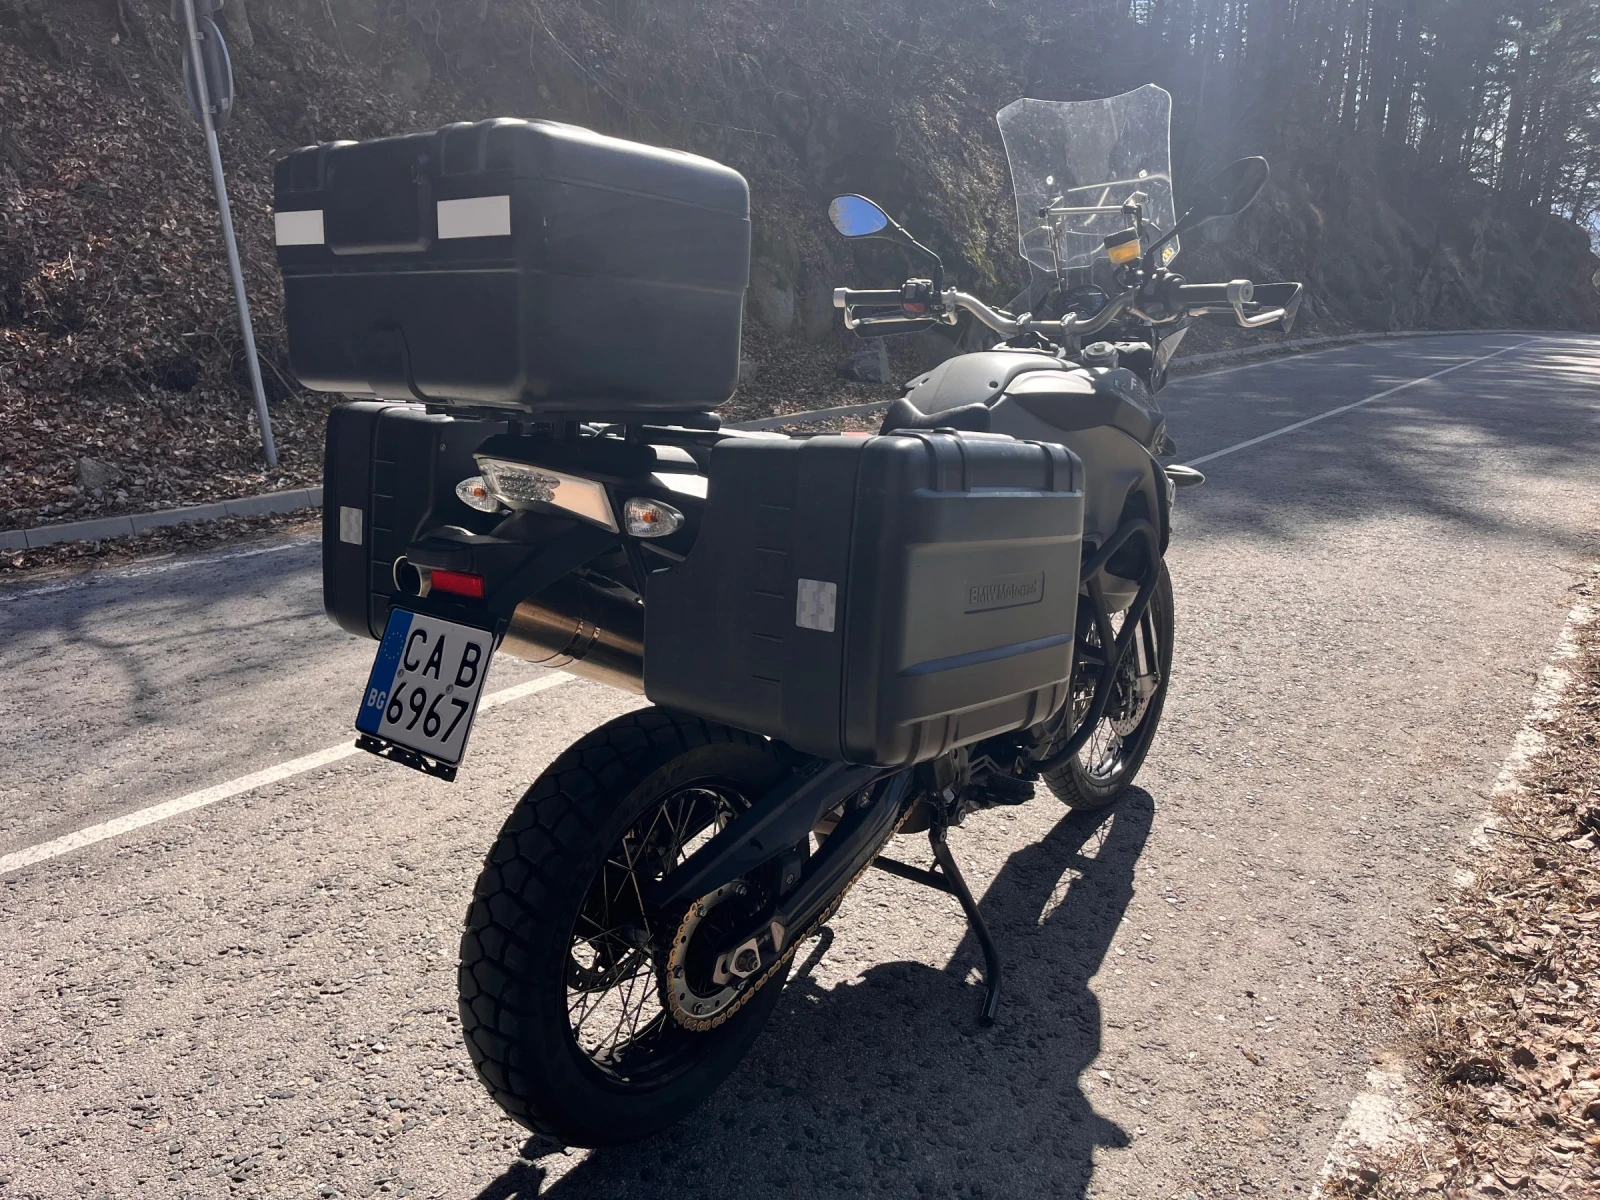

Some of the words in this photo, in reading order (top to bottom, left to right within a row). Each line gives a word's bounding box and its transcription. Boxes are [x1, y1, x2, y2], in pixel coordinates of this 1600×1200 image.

[969, 584, 997, 604] BMW
[403, 629, 446, 680] CA
[454, 641, 482, 688] B
[367, 687, 387, 710] BG
[386, 682, 470, 743] 6967
